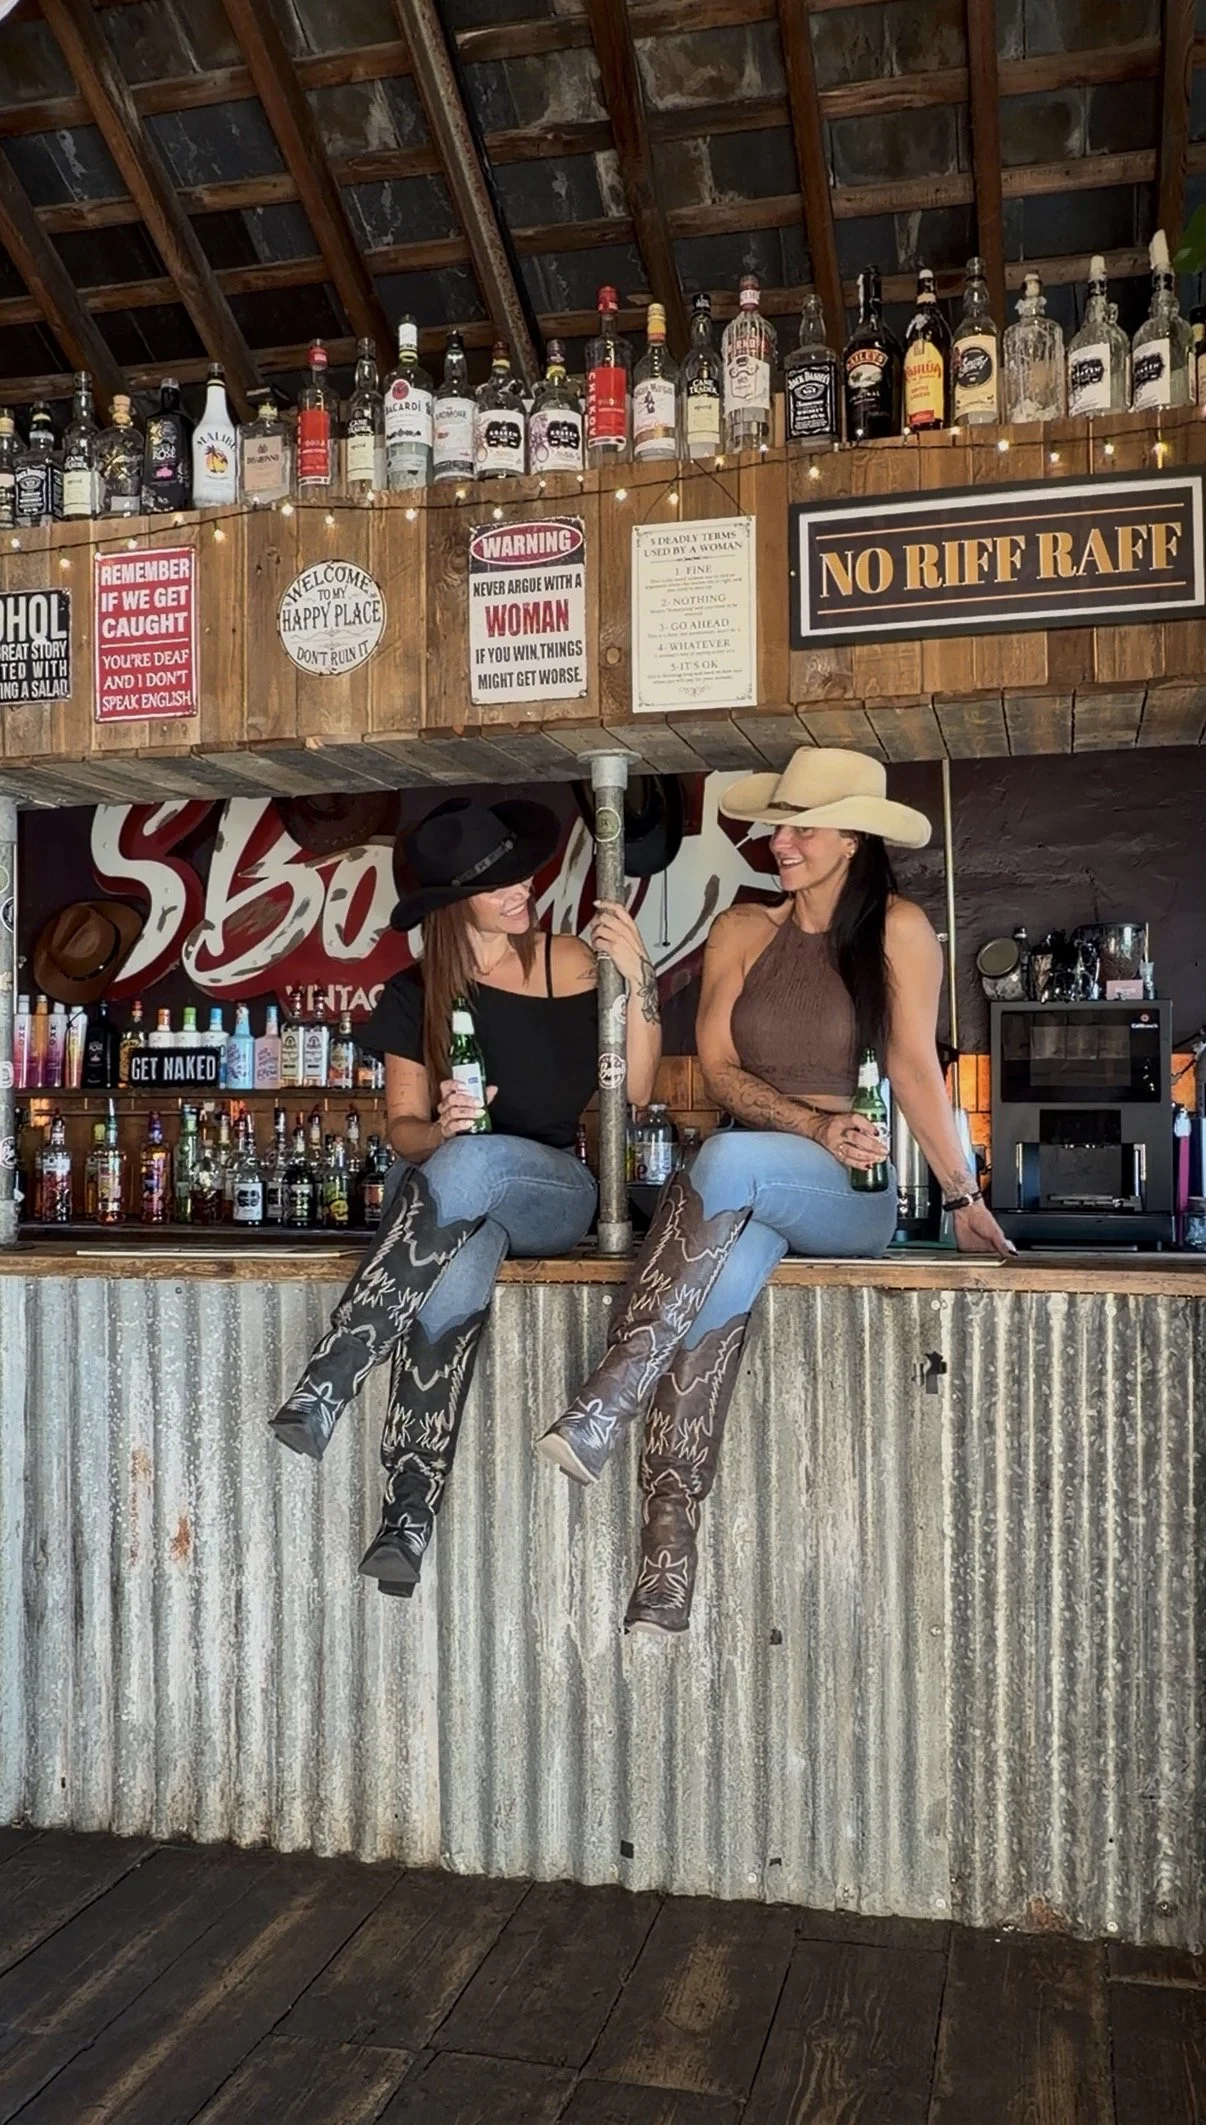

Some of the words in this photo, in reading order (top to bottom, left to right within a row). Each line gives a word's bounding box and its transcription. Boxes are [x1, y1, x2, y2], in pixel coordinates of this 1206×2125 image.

[481, 531, 572, 559] WARNING
[657, 534, 698, 546] DEADLY
[701, 530, 737, 542] TERMS
[643, 546, 671, 558] USED
[672, 545, 686, 555] BY
[689, 545, 698, 554] A
[699, 541, 743, 552] WOMAN
[819, 547, 895, 598] NO
[902, 535, 1026, 591] RIFF
[1035, 521, 1183, 580] RAFF
[101, 558, 190, 585] REMEMBER
[686, 564, 712, 575] FINE
[286, 564, 373, 605] WELCOME
[316, 587, 332, 602] TO
[332, 585, 347, 600] MY
[473, 578, 506, 597] NEVER
[508, 576, 542, 595] ARGUE
[543, 574, 573, 592] WITH
[573, 573, 582, 589] A
[101, 591, 119, 613] IF
[122, 588, 151, 610] WE
[153, 585, 189, 607] GET
[673, 593, 727, 606] NOTHING
[102, 612, 187, 638] CAUGHT
[282, 602, 330, 633] HAPPY
[334, 599, 382, 627] PLACE
[485, 598, 570, 638] WOMAN
[670, 621, 687, 632] GO
[689, 617, 730, 629] AHEAD
[0, 643, 29, 661] REAT
[31, 640, 67, 660] STORY
[296, 646, 328, 666] DON'T
[330, 645, 357, 666] RUIN
[357, 639, 370, 657] IT
[475, 647, 486, 665] IF
[486, 646, 511, 664] YOU
[540, 640, 583, 659] THINGS
[669, 639, 731, 651] WHATEVER
[0, 662, 26, 680] TED
[32, 659, 67, 678] WITH
[102, 651, 152, 670] YOU'RE
[154, 648, 190, 666] DEAF
[0, 681, 19, 699] ING
[21, 680, 29, 698] A
[31, 679, 68, 697] SALAD
[103, 673, 134, 690] AND
[137, 673, 142, 687] I
[145, 669, 187, 687] DON'T
[477, 672, 515, 690] MIGHT
[516, 670, 538, 687] GET
[102, 694, 140, 712] SPEAK
[141, 690, 191, 710] ENGLISH
[132, 1056, 157, 1081] GET
[163, 1055, 216, 1081] NAKED
